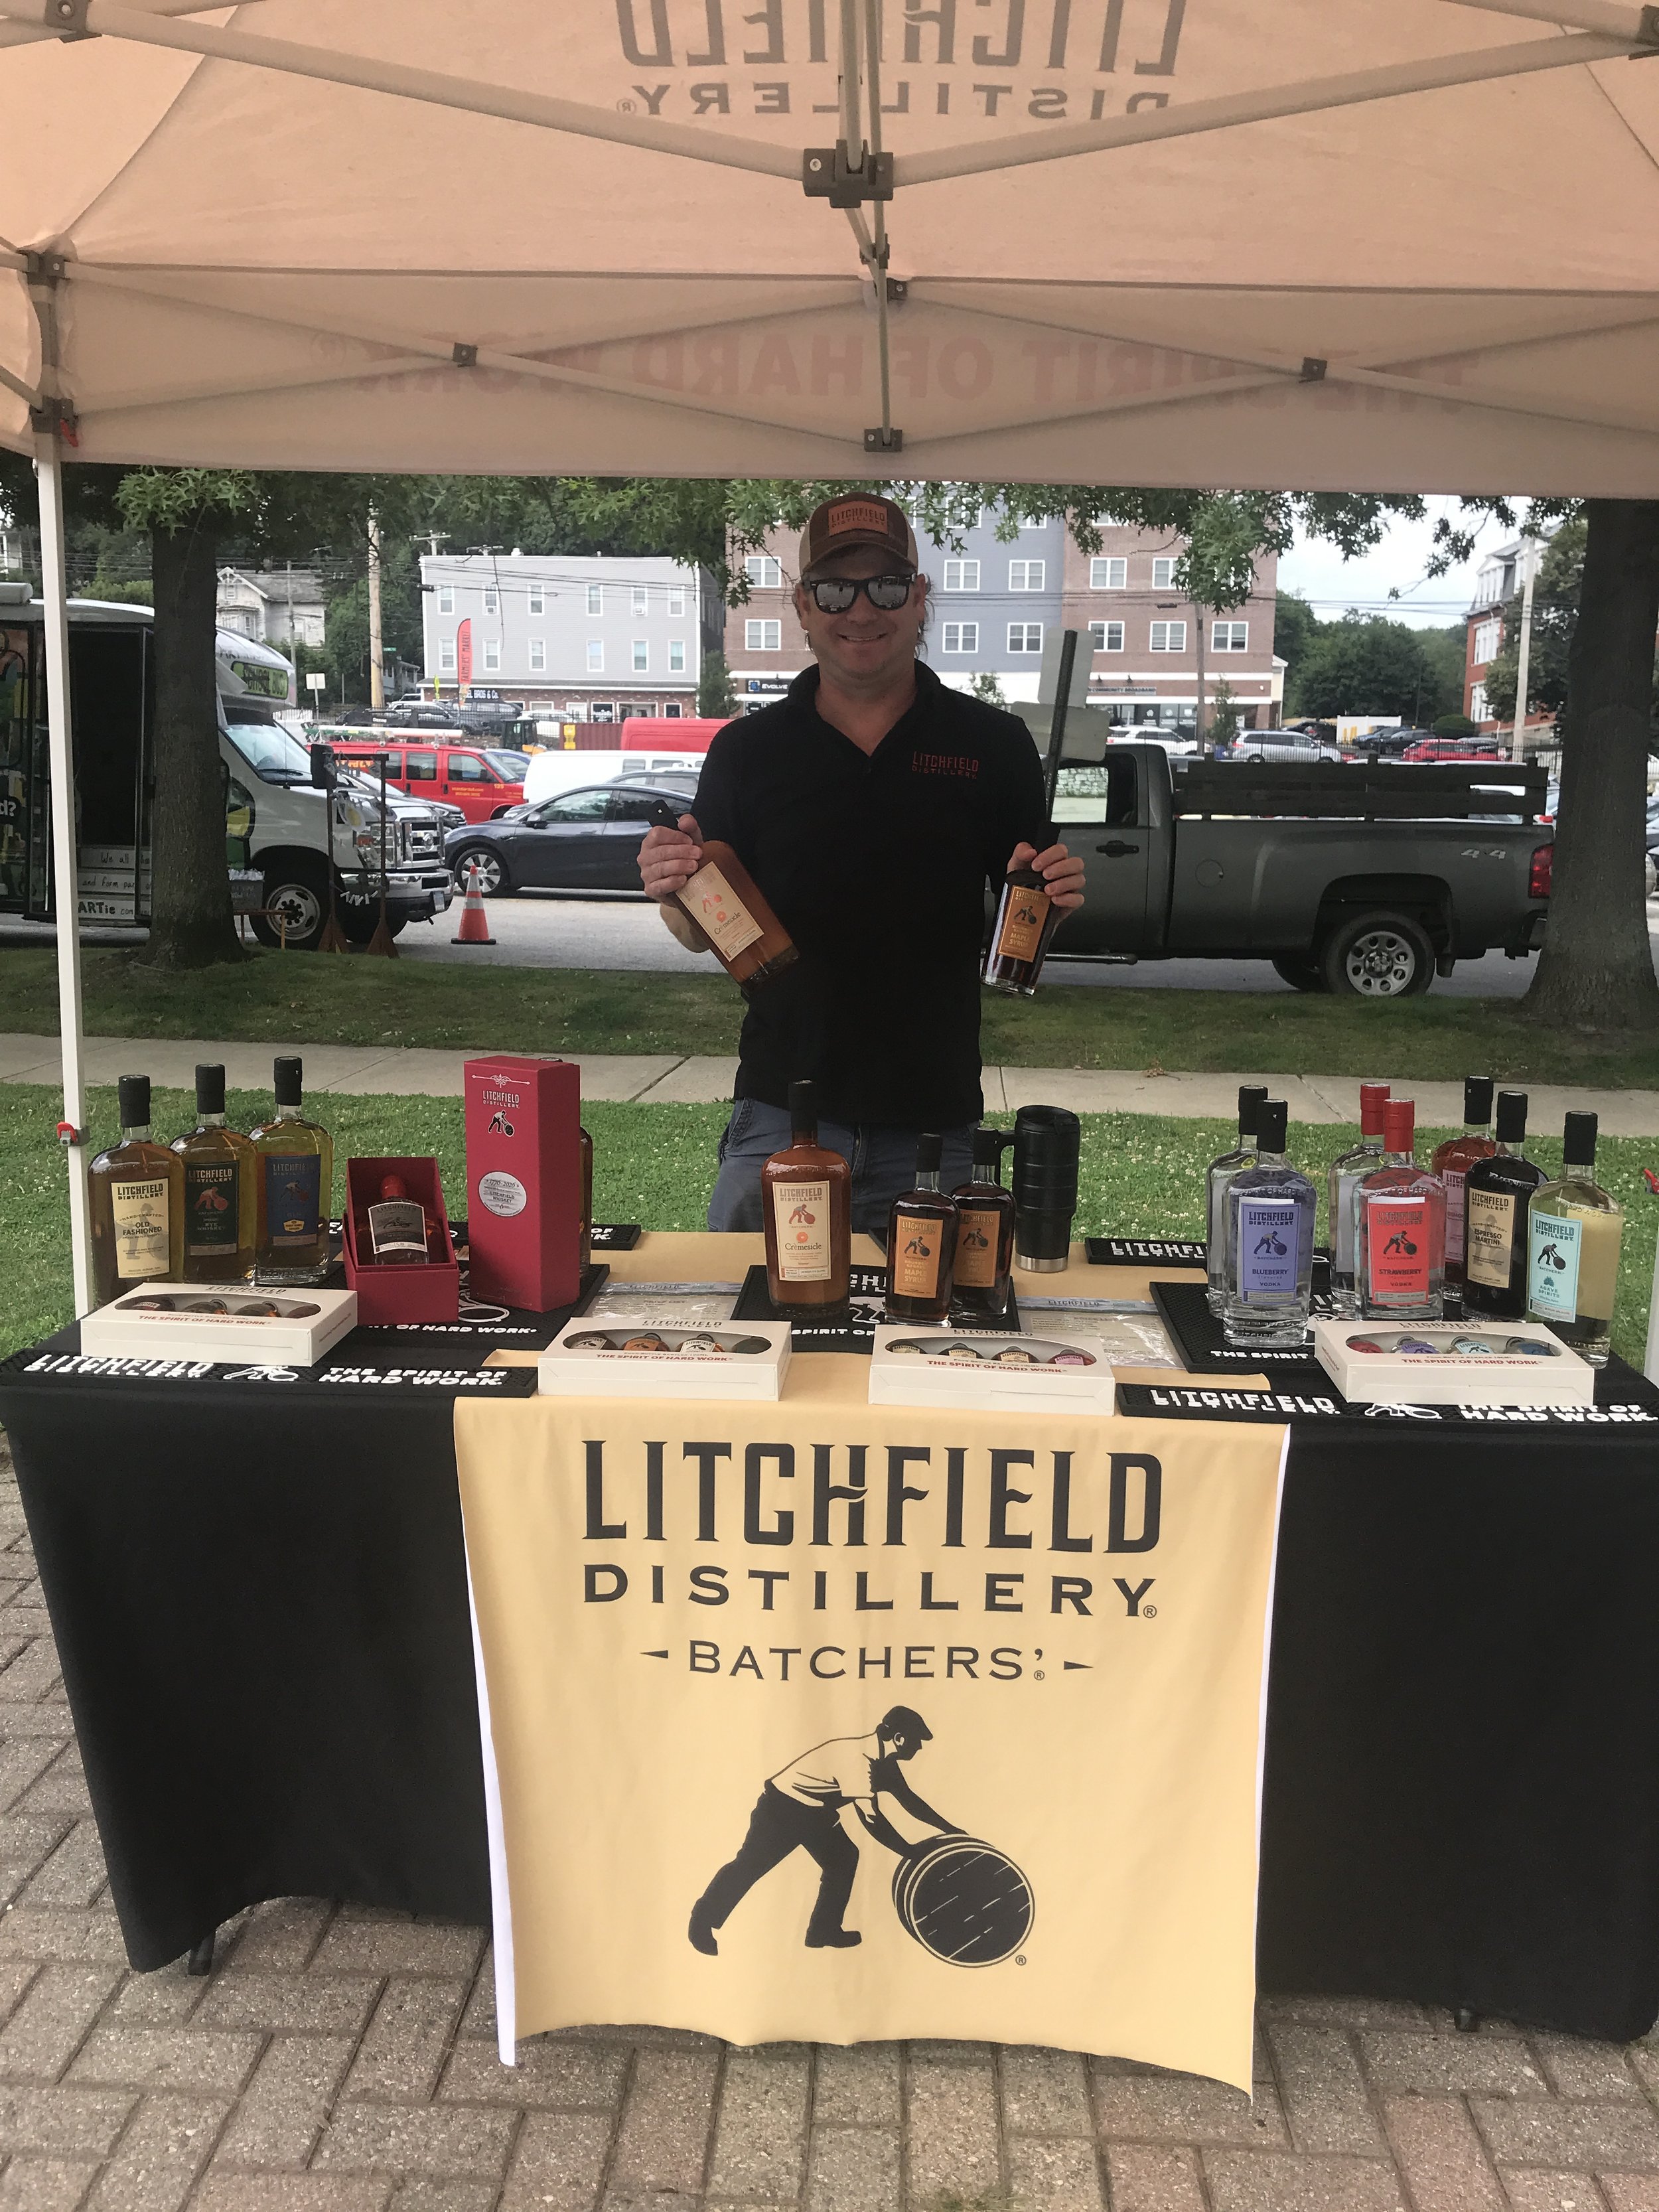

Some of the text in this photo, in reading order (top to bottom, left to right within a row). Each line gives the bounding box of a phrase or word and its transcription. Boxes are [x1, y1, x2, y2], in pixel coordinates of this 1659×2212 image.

[831, 508, 885, 522] LITCHFIELD
[831, 516, 884, 528] DISTILLERY
[474, 690, 486, 699] BROS
[486, 690, 491, 699] &
[913, 751, 978, 772] LITCHFIELD
[101, 852, 113, 863] We
[119, 853, 129, 863] all
[82, 876, 96, 886] and
[102, 877, 118, 888] form
[78, 901, 115, 915] ARTie
[482, 1090, 520, 1104] LITCHFIELD
[483, 1100, 520, 1109] DISTILLERY
[188, 1169, 232, 1179] LITCHFIELD
[1447, 1173, 1464, 1184] LITCH
[117, 1183, 163, 1195] LITCHFIELD
[489, 1179, 515, 1188] 1776-2026
[780, 1187, 822, 1197] LITCHFIELD
[1472, 1193, 1508, 1207] LITCHFIELD
[1472, 1201, 1508, 1211] DISTILLERY
[1249, 1212, 1293, 1221] LITCHFIELD
[1377, 1211, 1423, 1221] LITCHFIELD
[123, 1226, 162, 1235] FASHIONED
[902, 1220, 936, 1231] LITCHFIELD
[1536, 1219, 1575, 1236] LITCHFIELD
[1475, 1228, 1502, 1239] ESPRESSO
[1536, 1229, 1574, 1241] DISTILLERY
[1475, 1234, 1500, 1245] MARTINI
[1111, 1242, 1207, 1255] LITCHFI
[1539, 1289, 1559, 1298] SPIRITS
[31, 1355, 214, 1373] LITCHFIELD
[328, 1367, 376, 1376] THE
[387, 1369, 468, 1378] SPIRIT
[319, 1374, 403, 1384] HARD
[1150, 1389, 1336, 1410] LITCHFIELD
[1461, 1410, 1549, 1421] HARD
[582, 1440, 1162, 1553] LITCHFIELD
